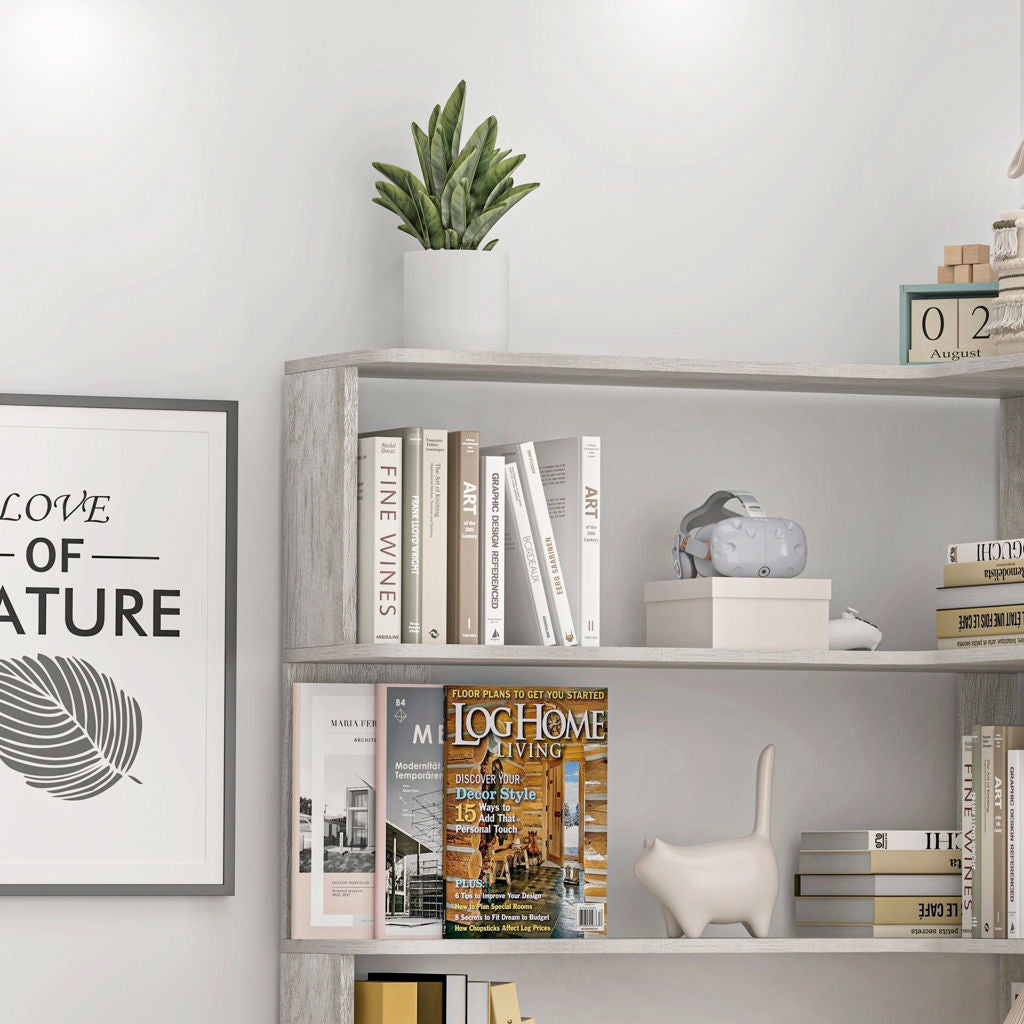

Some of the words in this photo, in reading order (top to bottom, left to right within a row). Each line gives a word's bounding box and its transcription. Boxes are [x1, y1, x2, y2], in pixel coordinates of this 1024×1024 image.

[921, 306, 945, 341] 0
[971, 305, 991, 340] 2
[930, 348, 982, 361] August
[380, 466, 397, 521] FINE
[463, 481, 477, 516] ART
[491, 472, 500, 513] GRAPHIC
[0, 490, 111, 524] LOVE
[411, 495, 420, 519] FRANK
[584, 485, 599, 519] ART
[411, 520, 420, 544] LLOYD
[491, 515, 499, 548] DESIGN
[25, 536, 85, 573] OF
[411, 545, 420, 575] WRIGHT
[522, 535, 540, 584] BORDEAUX
[545, 537, 558, 574] SAARINEN
[379, 533, 397, 616] WINES
[491, 550, 499, 610] REFERENCED
[553, 576, 564, 595] EERO
[958, 615, 973, 632] CAFÉ
[973, 614, 980, 629] LE
[980, 613, 993, 629] FOIS
[994, 612, 1005, 627] UNE
[1005, 611, 1021, 628] ÉTAIT
[395, 698, 406, 707] 84
[452, 689, 480, 698] FLOOR
[483, 690, 511, 699] PLANS
[514, 690, 525, 699] TO
[527, 690, 543, 699] GET
[546, 690, 564, 699] YOU
[567, 690, 605, 700] STARTED
[331, 719, 359, 728] MARIA
[497, 742, 563, 759] LIVING
[395, 761, 441, 771] Modernität
[455, 773, 496, 784] DISCOVER
[498, 772, 520, 784] YOUR
[455, 787, 497, 800] Decor
[500, 787, 536, 804] Style
[963, 764, 973, 817] FINE
[994, 776, 1002, 810] ART
[455, 802, 477, 823] 15
[478, 803, 500, 812] Ways
[502, 803, 511, 812] to
[478, 814, 495, 823] Add
[497, 814, 516, 823] That
[455, 824, 491, 834] Personal
[494, 824, 518, 834] Touch
[963, 829, 973, 911] WINES
[454, 879, 485, 889] PLUS:
[461, 892, 473, 900] Tips
[477, 903, 489, 911] Plan
[491, 903, 512, 911] Special
[918, 903, 944, 920] CAFÉ
[946, 903, 959, 917] LE
[528, 914, 550, 922] Budget
[469, 924, 500, 933] Chopsticks
[520, 925, 532, 933] Log
